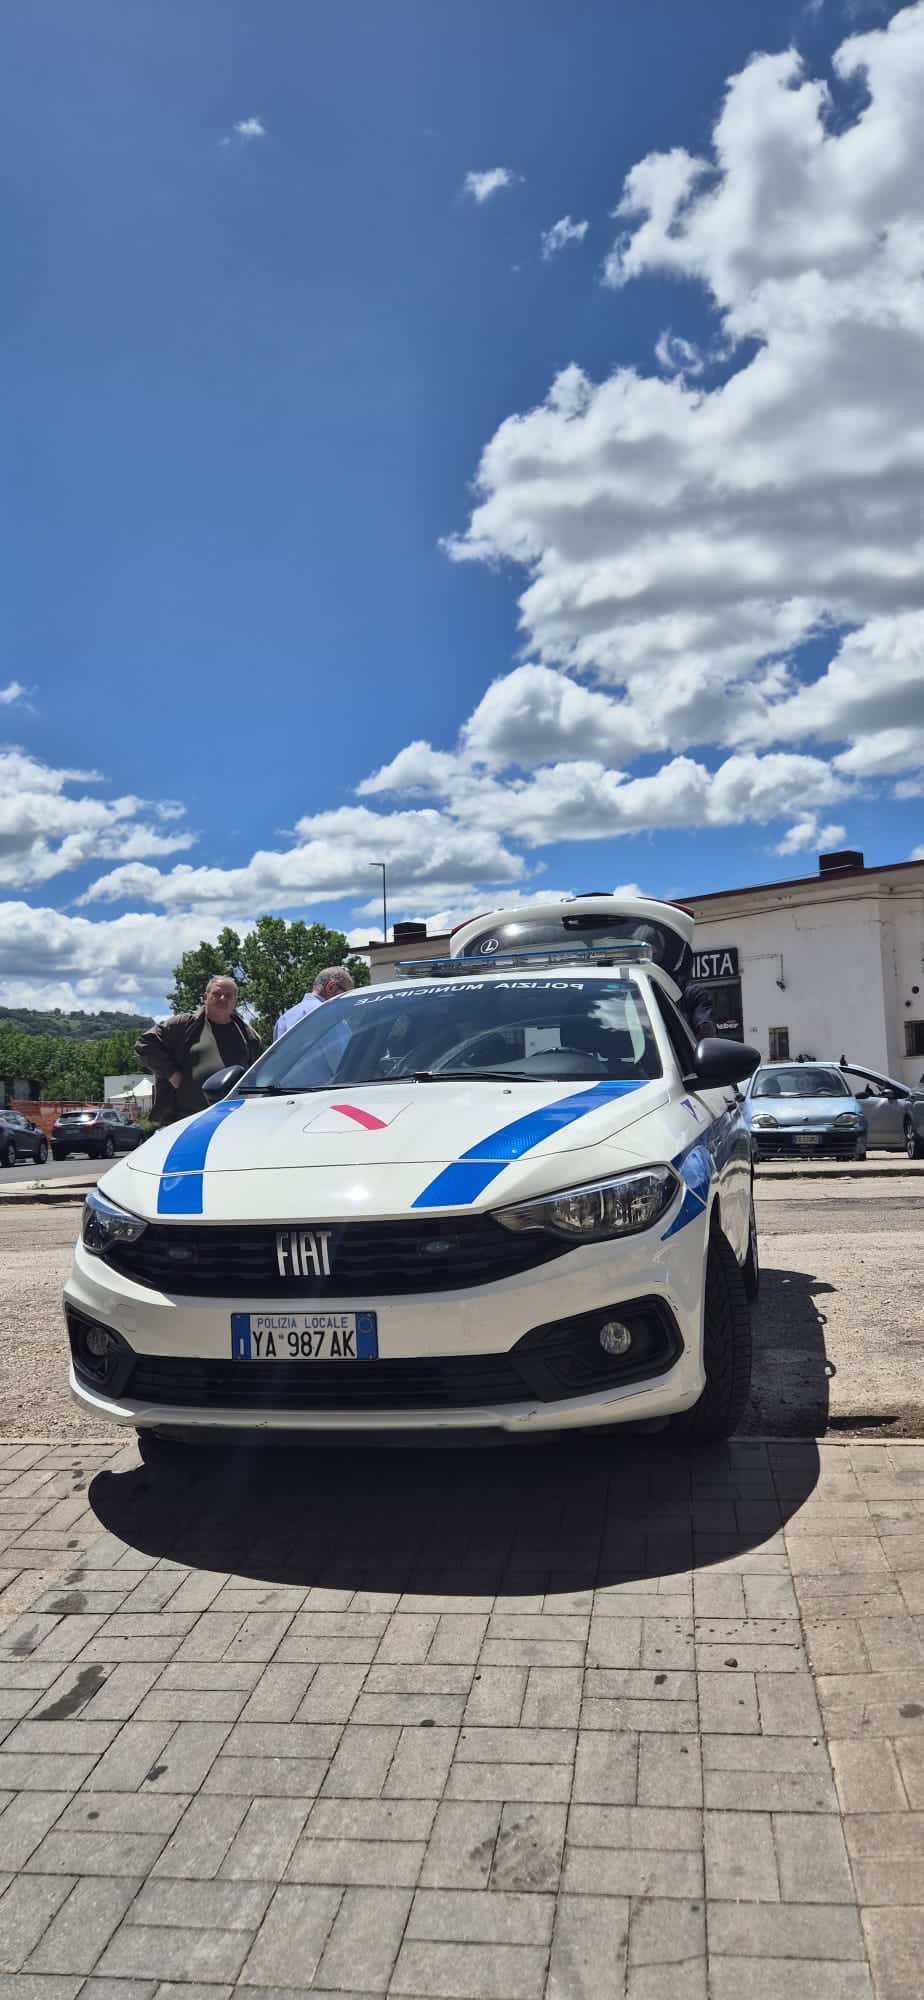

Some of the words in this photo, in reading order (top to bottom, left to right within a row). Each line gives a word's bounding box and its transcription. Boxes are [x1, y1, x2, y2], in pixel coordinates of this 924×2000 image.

[276, 1232, 332, 1276] FIAT
[257, 1317, 297, 1329] POLIZIA
[304, 1317, 349, 1329] LOCALE
[252, 1331, 277, 1357] YA
